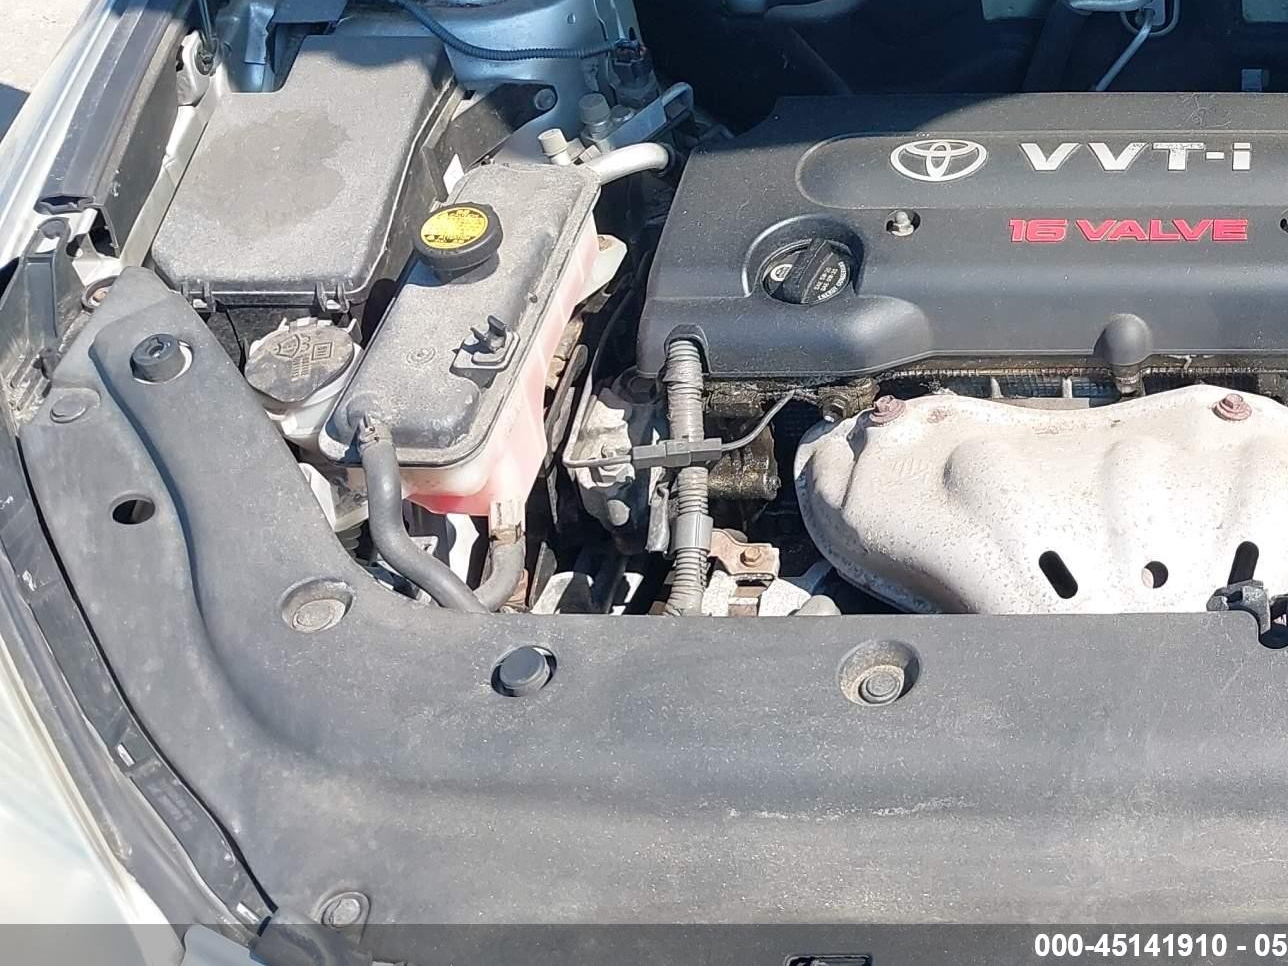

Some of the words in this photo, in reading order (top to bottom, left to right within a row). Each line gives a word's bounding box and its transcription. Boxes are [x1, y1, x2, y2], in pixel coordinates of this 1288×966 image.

[1020, 142, 1251, 171] VVT-i
[1009, 219, 1068, 242] 16
[1075, 219, 1248, 242] VALVE
